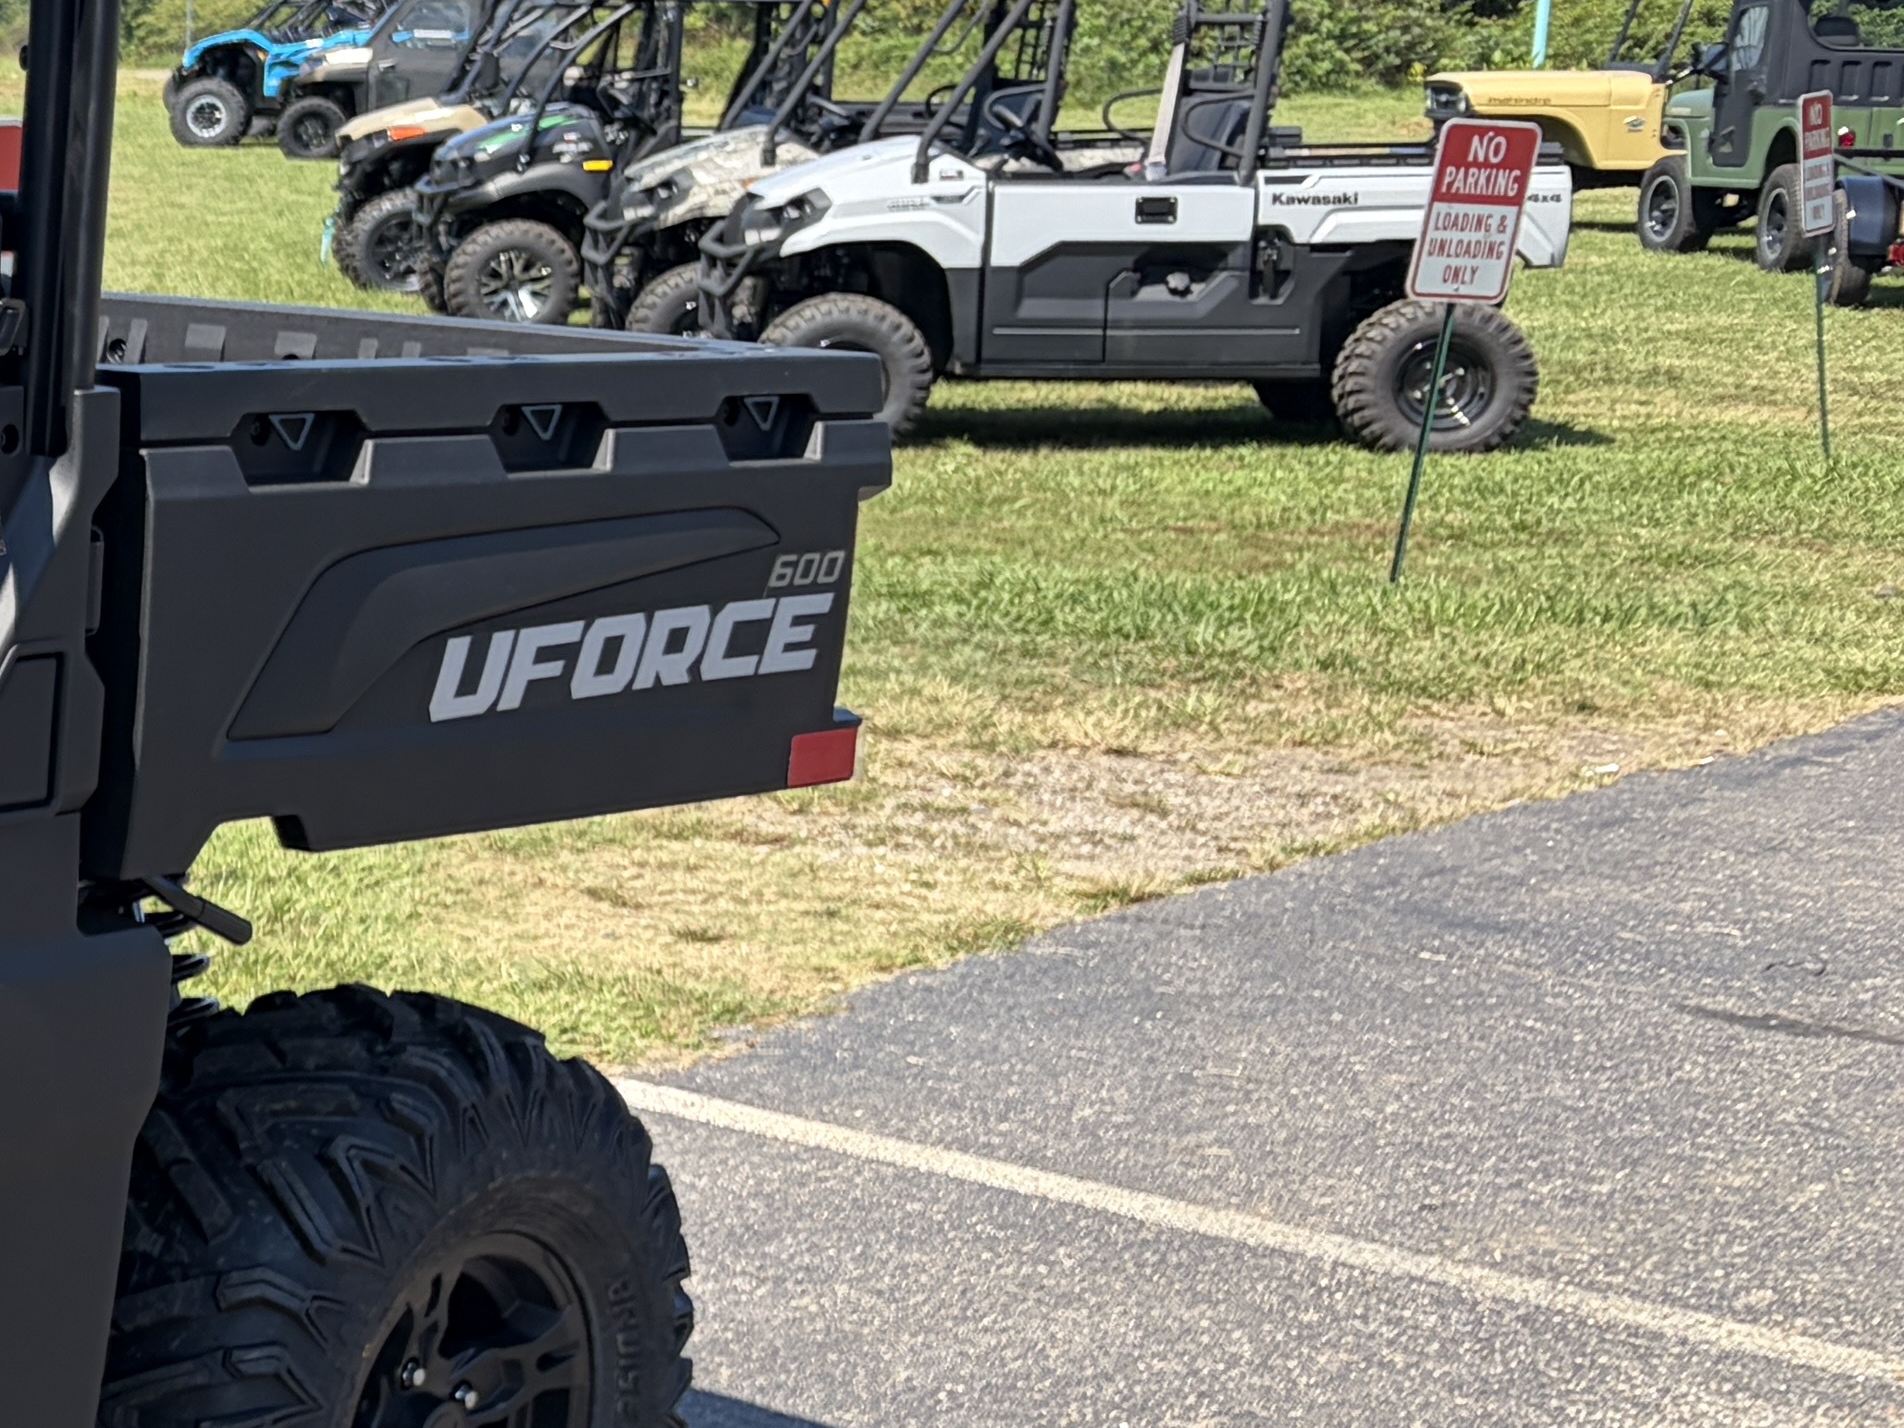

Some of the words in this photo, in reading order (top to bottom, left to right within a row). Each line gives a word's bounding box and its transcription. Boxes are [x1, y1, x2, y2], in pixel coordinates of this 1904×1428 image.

[1467, 132, 1507, 164] NO
[1441, 166, 1522, 198] PARKING
[1272, 191, 1359, 206] Kawasaki
[1434, 211, 1493, 234] LOADING
[1496, 214, 1508, 235] &
[1428, 237, 1505, 260] UNLOADING
[1442, 264, 1480, 285] ONLY
[766, 548, 846, 589] 600
[428, 592, 836, 723] UFORCE
